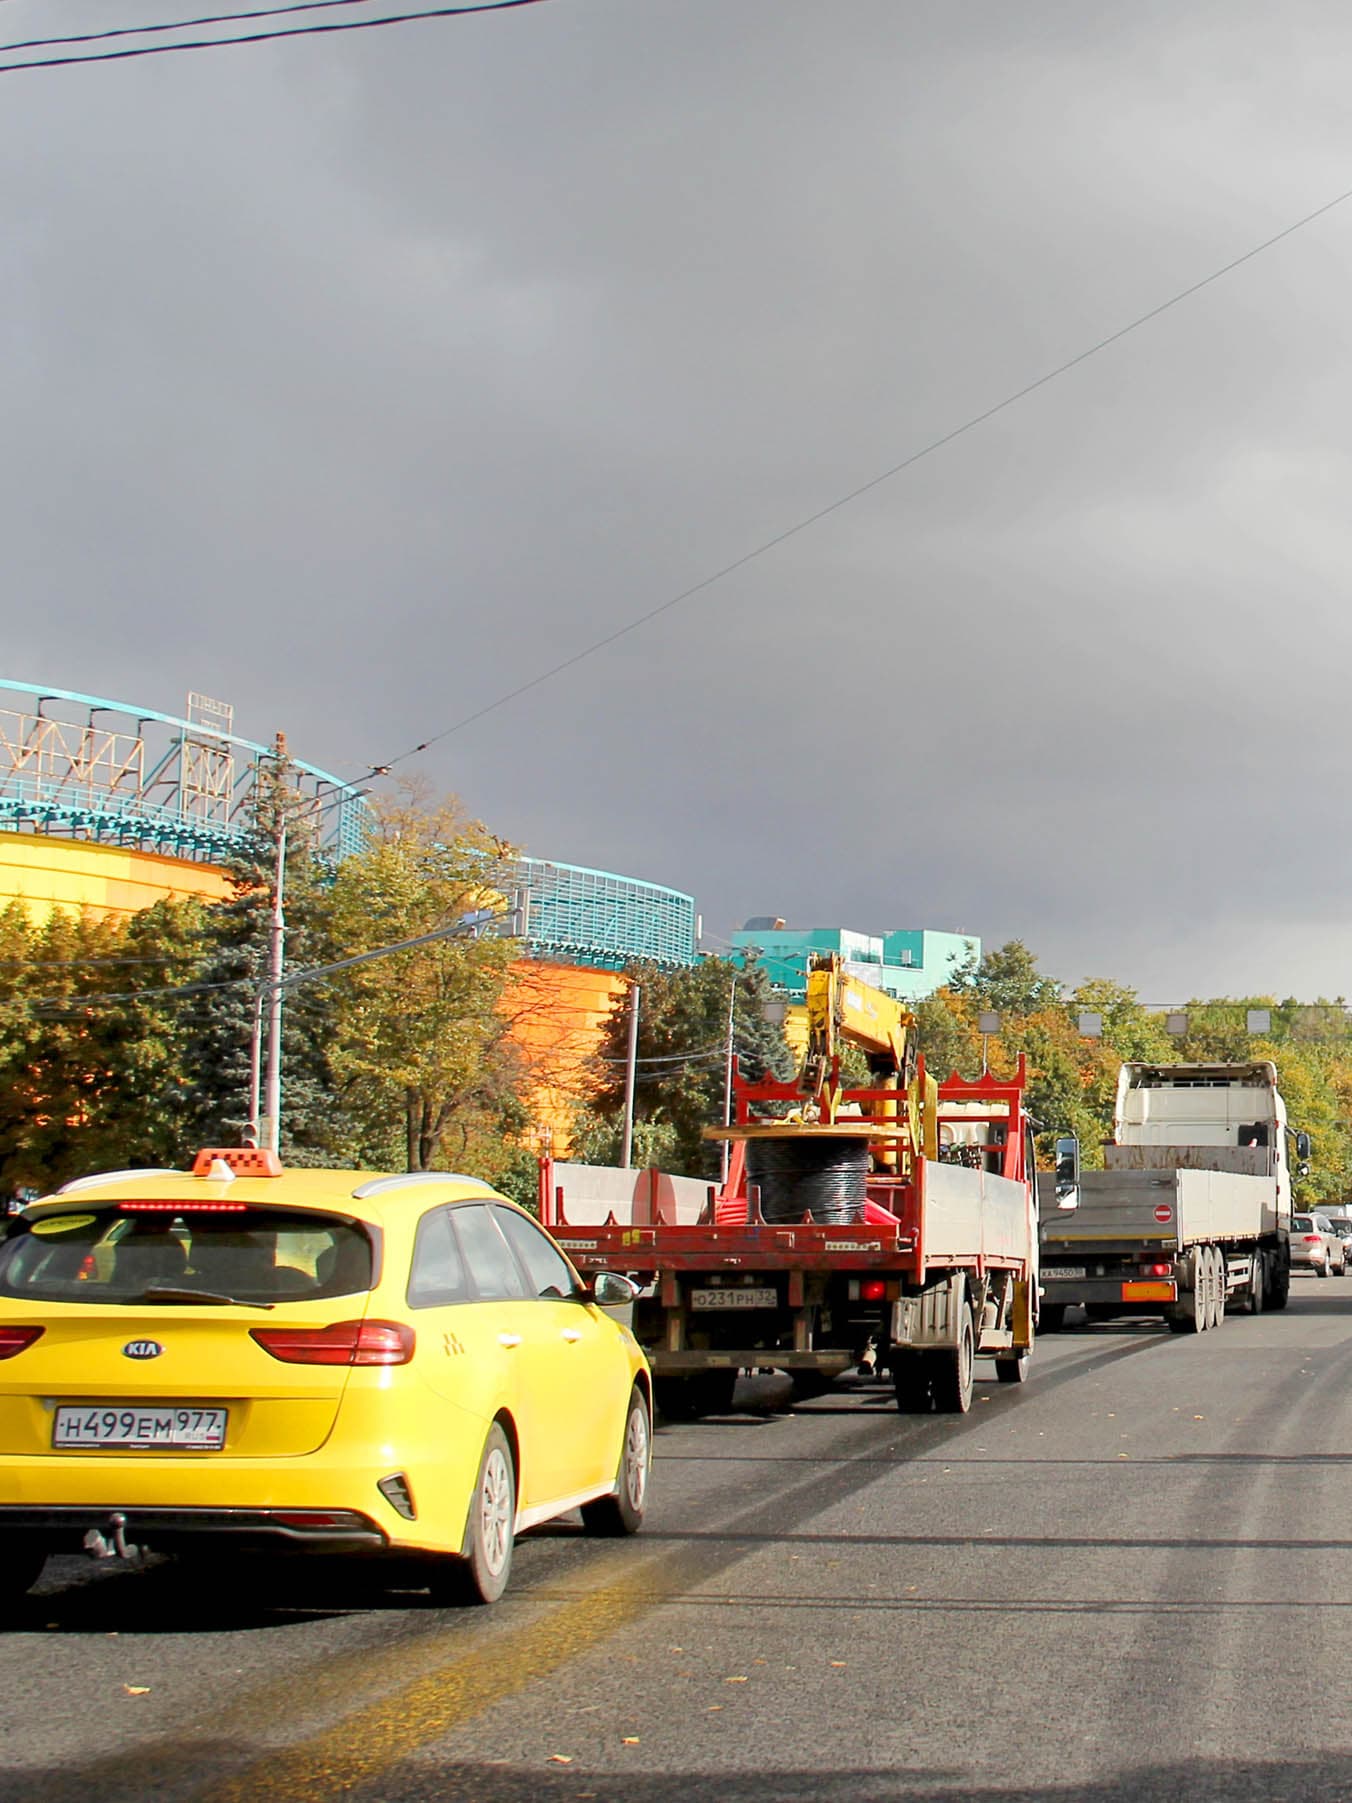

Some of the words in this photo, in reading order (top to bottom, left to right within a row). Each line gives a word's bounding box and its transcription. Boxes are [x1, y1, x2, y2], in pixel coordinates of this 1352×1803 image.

[128, 1342, 158, 1355] KIA
[65, 1411, 172, 1438] Н499ЕМ
[177, 1411, 218, 1432] 977
